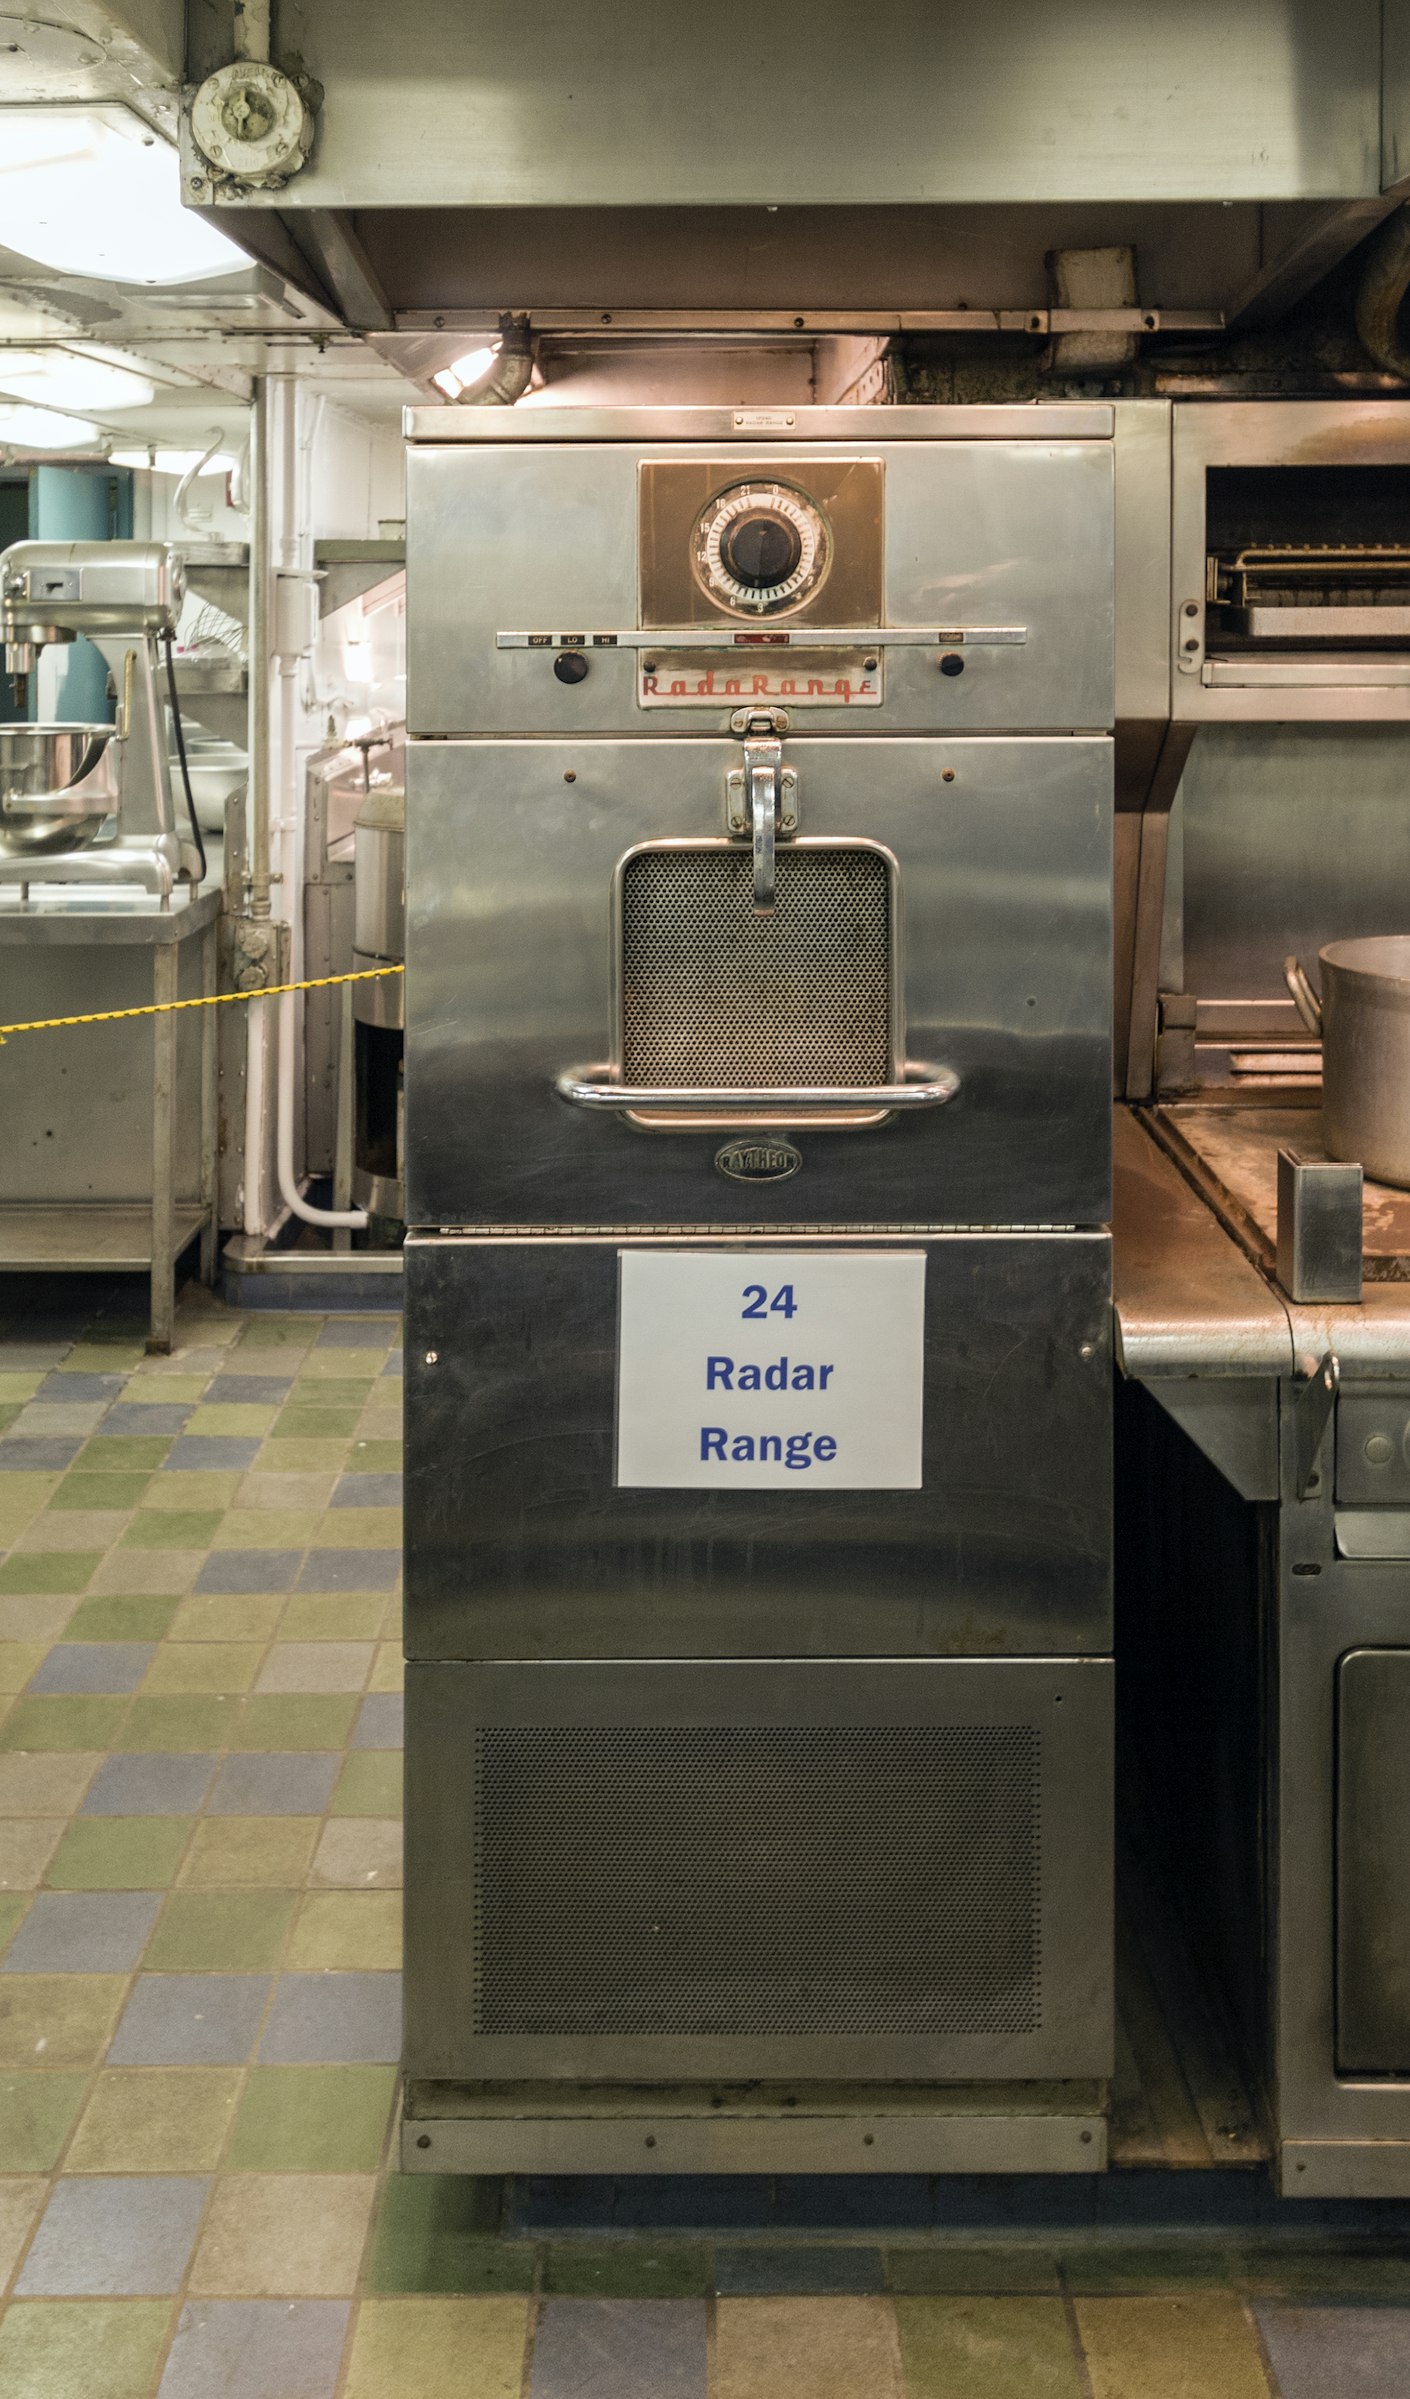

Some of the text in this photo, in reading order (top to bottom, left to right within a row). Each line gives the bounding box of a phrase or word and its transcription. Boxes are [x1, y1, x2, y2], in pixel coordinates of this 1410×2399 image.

[700, 523, 710, 533] 15
[697, 551, 707, 561] 12
[567, 636, 578, 644] LO
[643, 671, 877, 703] RadaRange
[742, 1285, 798, 1319] 24
[706, 1356, 834, 1391] Radar
[700, 1427, 837, 1470] Range
